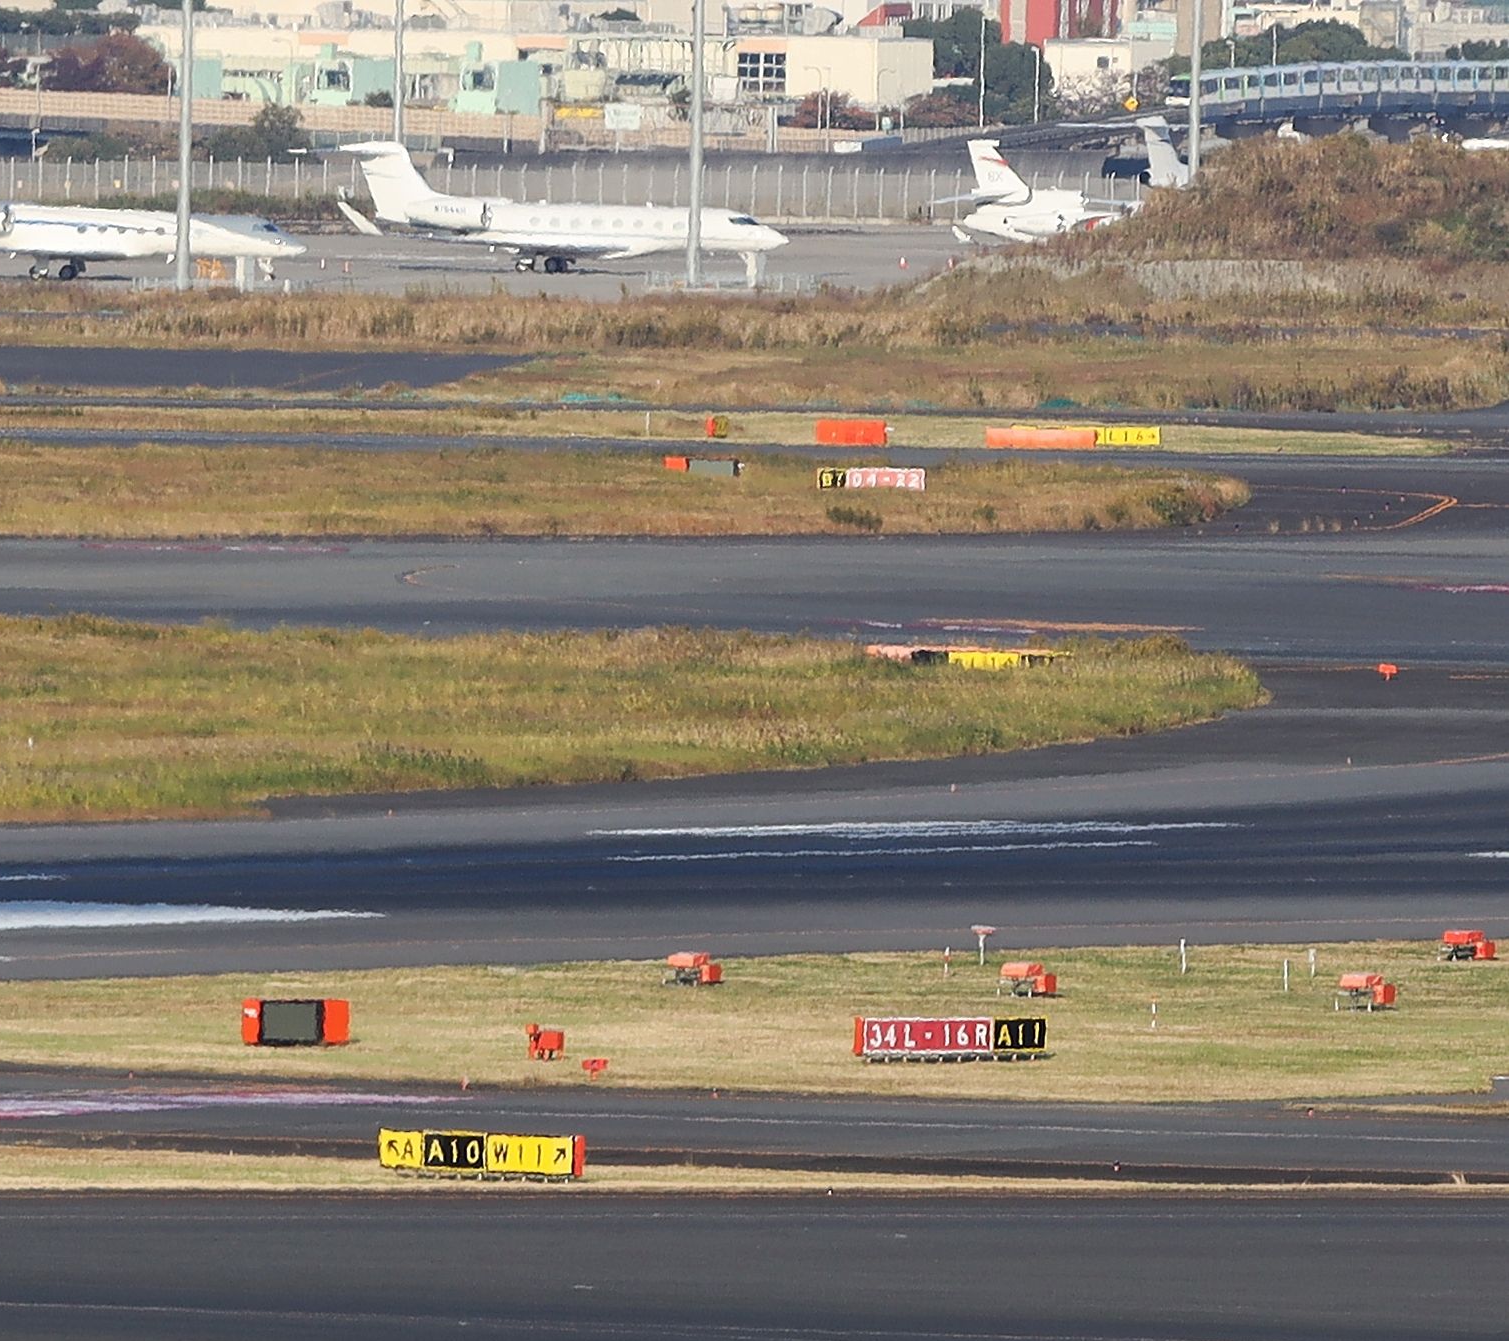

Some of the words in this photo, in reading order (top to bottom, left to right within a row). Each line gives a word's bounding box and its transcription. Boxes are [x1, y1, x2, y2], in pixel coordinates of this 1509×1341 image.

[998, 1022, 1040, 1046] A11
[403, 1138, 415, 1160] A
[427, 1138, 480, 1164] A10
[494, 1141, 542, 1167] W11
